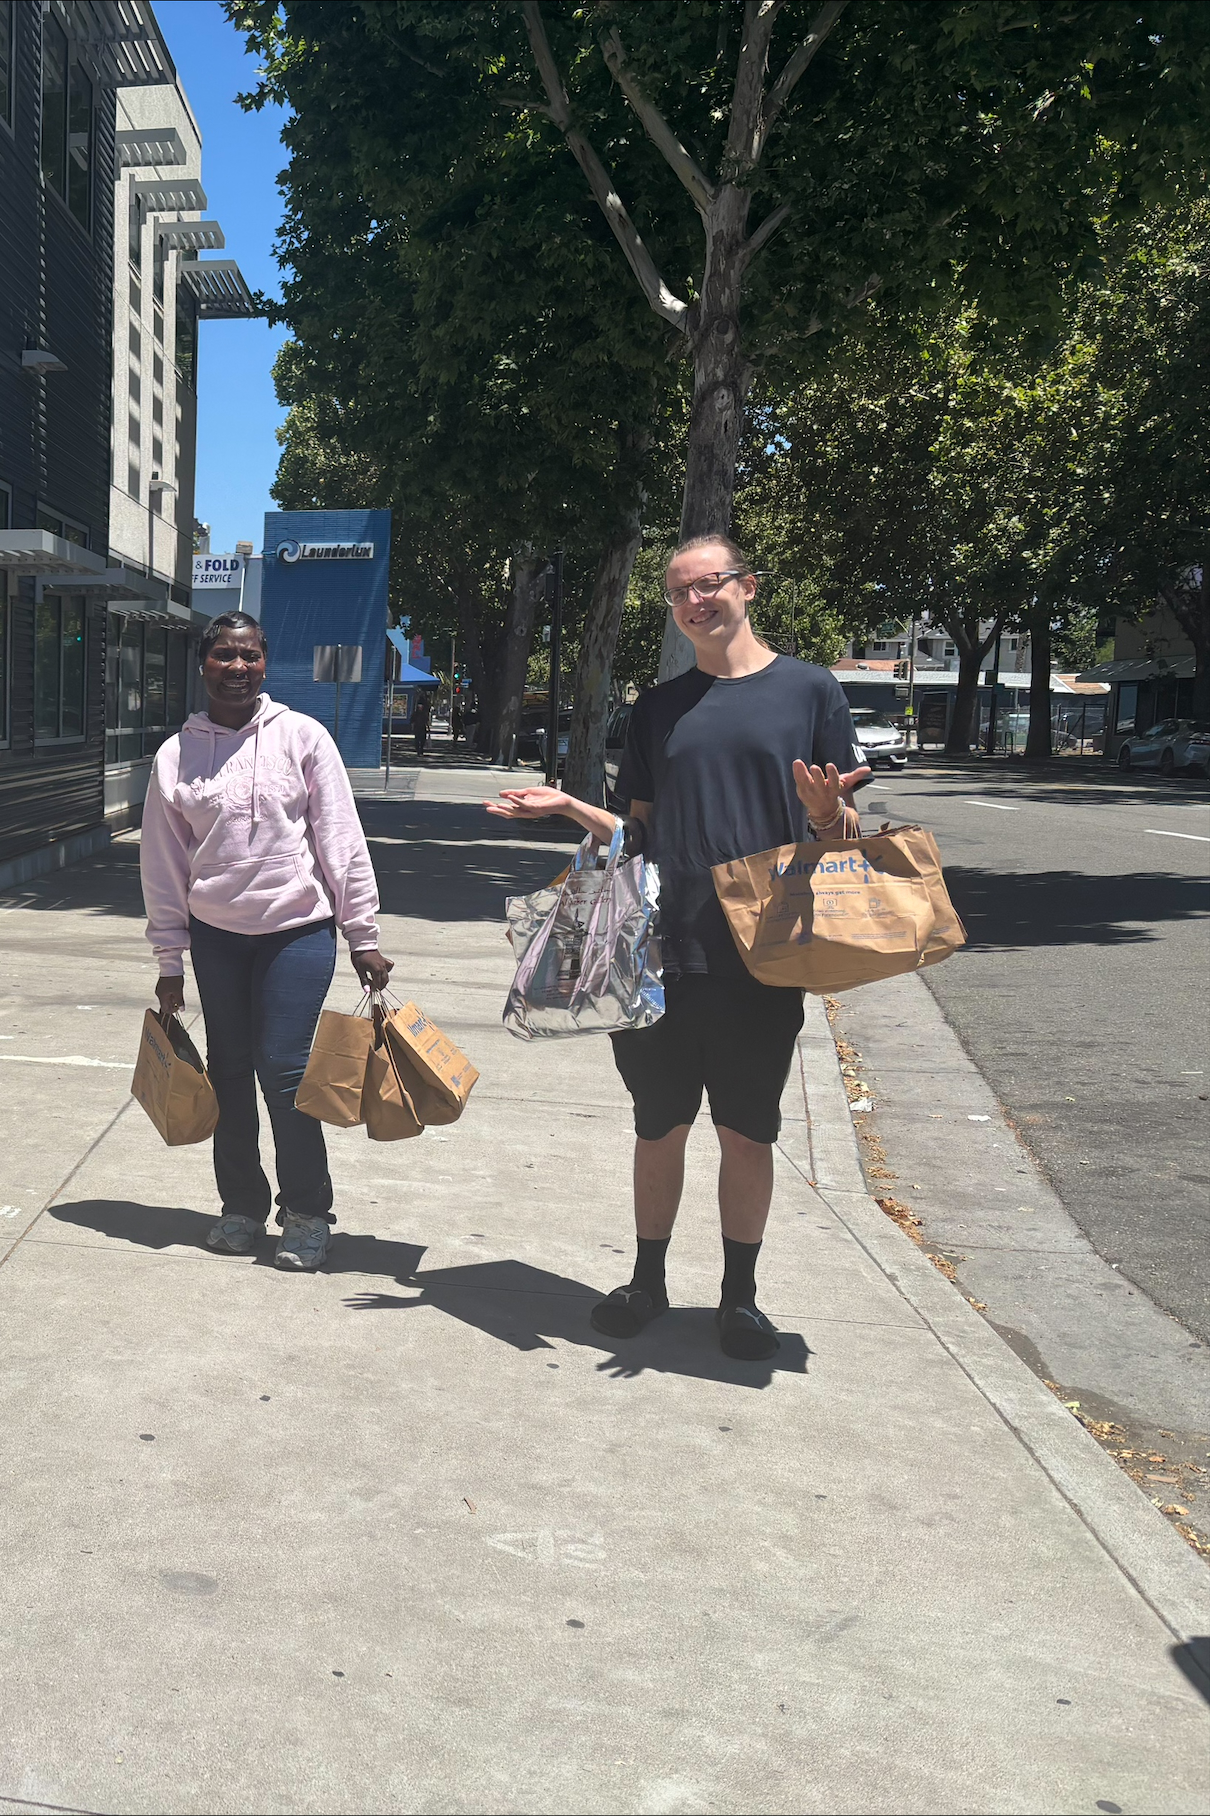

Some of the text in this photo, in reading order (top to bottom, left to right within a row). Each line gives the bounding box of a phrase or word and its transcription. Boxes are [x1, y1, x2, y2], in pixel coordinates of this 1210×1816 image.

[195, 559, 240, 571] & FOLD
[200, 574, 232, 583] SERVICE
